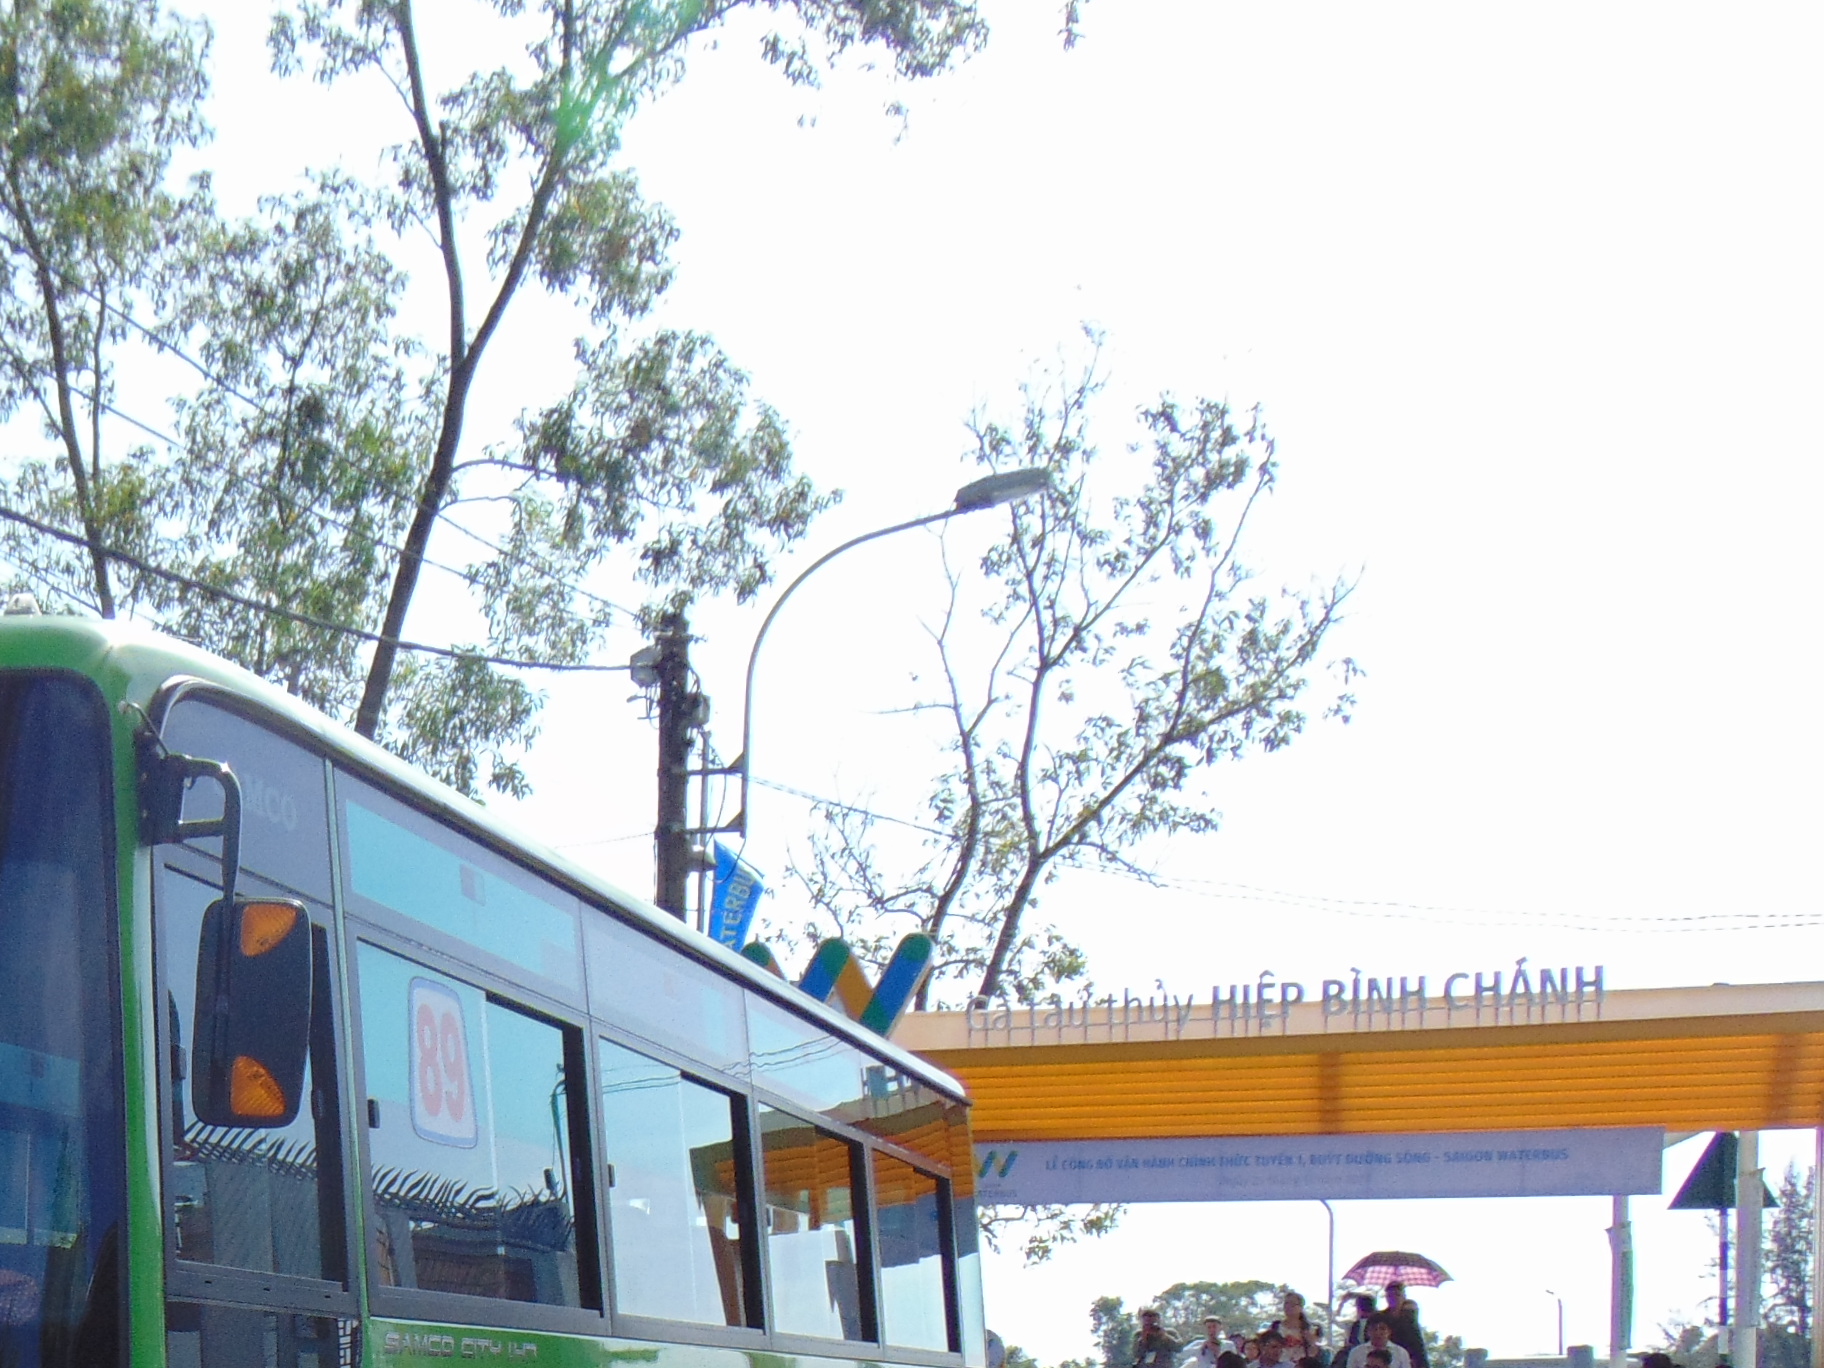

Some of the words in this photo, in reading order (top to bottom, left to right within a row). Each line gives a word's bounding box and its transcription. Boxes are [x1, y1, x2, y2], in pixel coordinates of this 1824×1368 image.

[966, 995, 1012, 1031] Ga
[1211, 969, 1305, 1029] HIỆP
[1322, 966, 1427, 1018] BÌNH
[1443, 956, 1605, 1011] CHÁNH
[415, 1002, 467, 1123] 89
[384, 1331, 455, 1358] SAMCO
